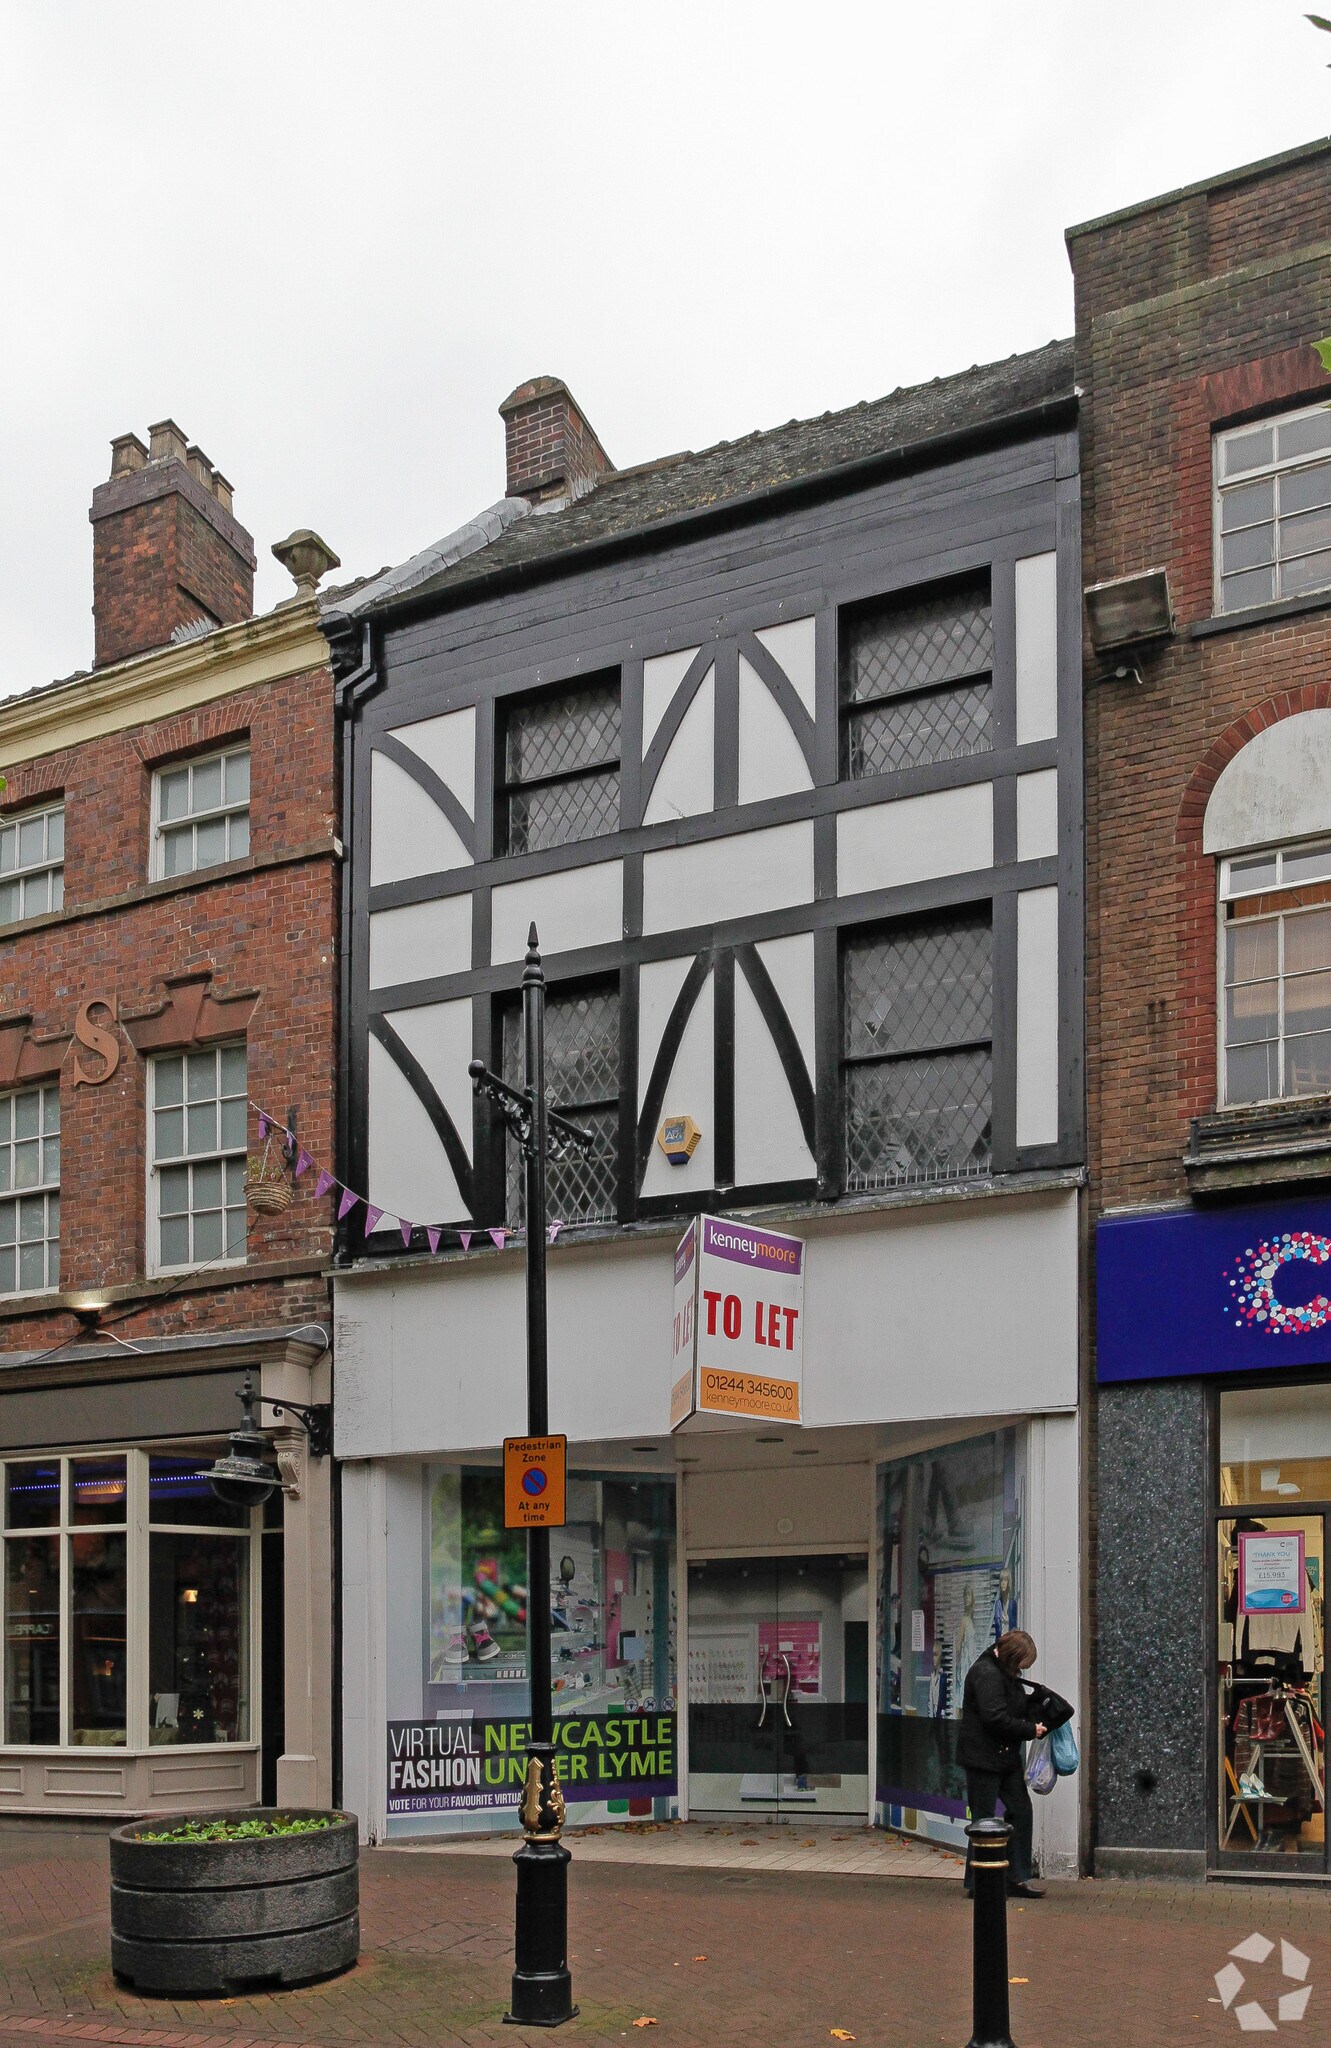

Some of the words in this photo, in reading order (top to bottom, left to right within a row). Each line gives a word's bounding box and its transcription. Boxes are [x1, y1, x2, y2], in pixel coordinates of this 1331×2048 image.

[710, 1225, 796, 1264] kenneymoore
[704, 1290, 742, 1340] TO
[755, 1301, 799, 1350] LET
[706, 1374, 745, 1392] 01244
[747, 1380, 794, 1400] 345600
[706, 1390, 794, 1413] kenneymoore.co.uk
[508, 1441, 561, 1452] Pedestrian
[522, 1453, 547, 1463] Zone
[518, 1501, 529, 1511] At
[533, 1502, 550, 1511] any
[523, 1513, 545, 1522] time
[390, 1726, 480, 1758] VIRTUAL
[390, 1757, 481, 1789] FASHION
[485, 1754, 588, 1785] UNER
[598, 1750, 673, 1778] LYME
[389, 1799, 410, 1811] VOTE
[411, 1798, 427, 1809] FOR
[429, 1797, 450, 1808] YOUR
[451, 1794, 493, 1807] FAVOURITE
[494, 1791, 524, 1804] VIRTUA
